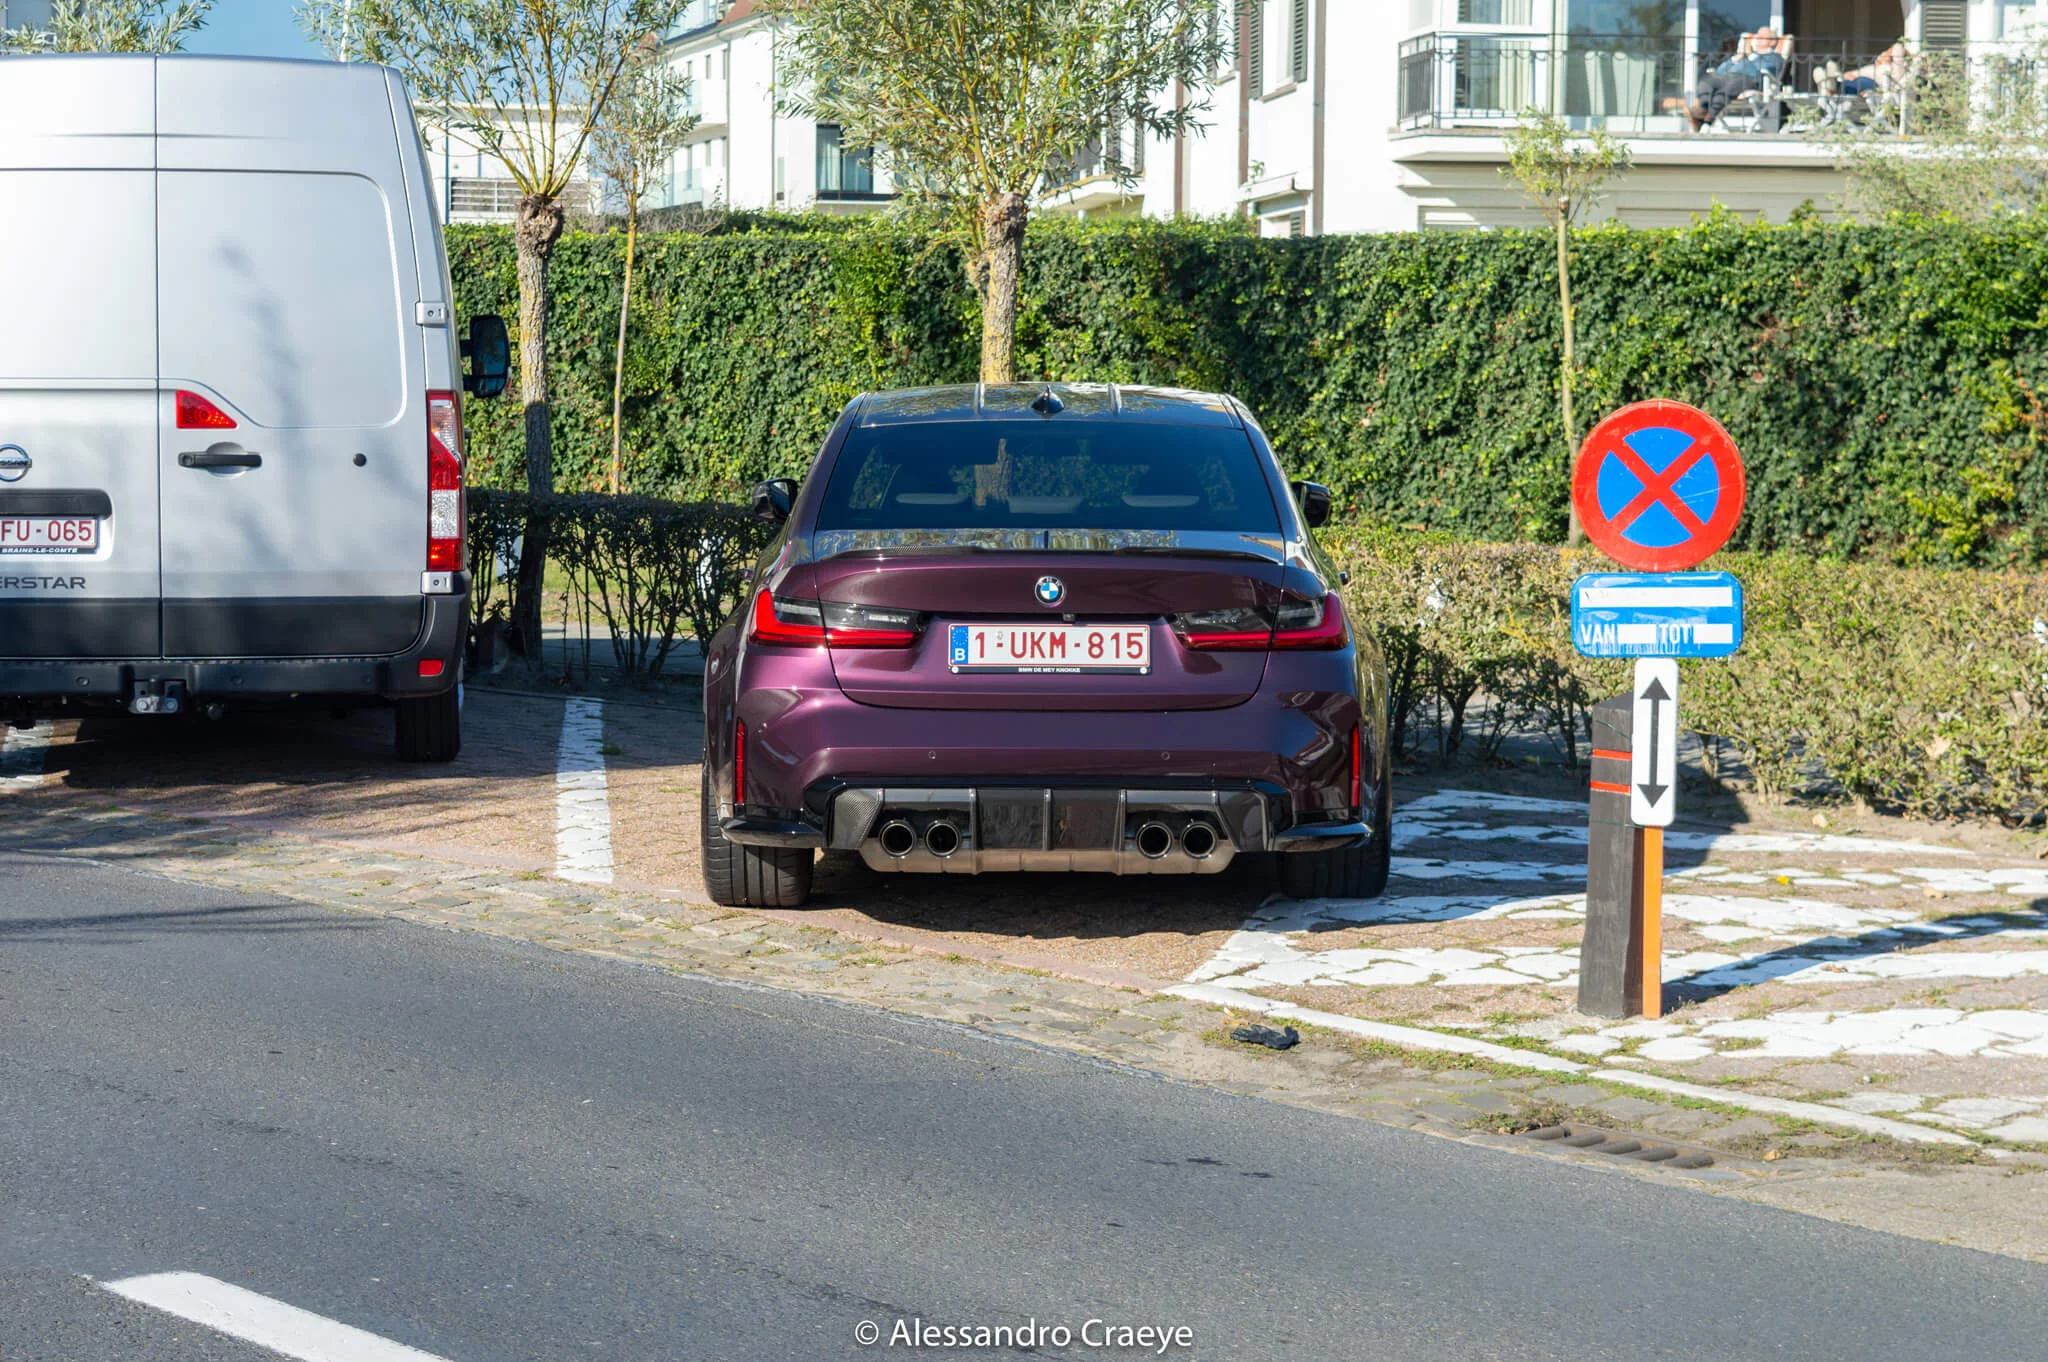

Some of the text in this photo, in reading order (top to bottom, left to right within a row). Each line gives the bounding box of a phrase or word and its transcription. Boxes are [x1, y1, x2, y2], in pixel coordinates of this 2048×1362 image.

[1, 520, 92, 541] FU-065
[0, 576, 86, 589] RSTAR
[1581, 623, 1691, 645] VAN TOT
[954, 648, 966, 661] B
[975, 631, 1144, 659] 1-UKM-815
